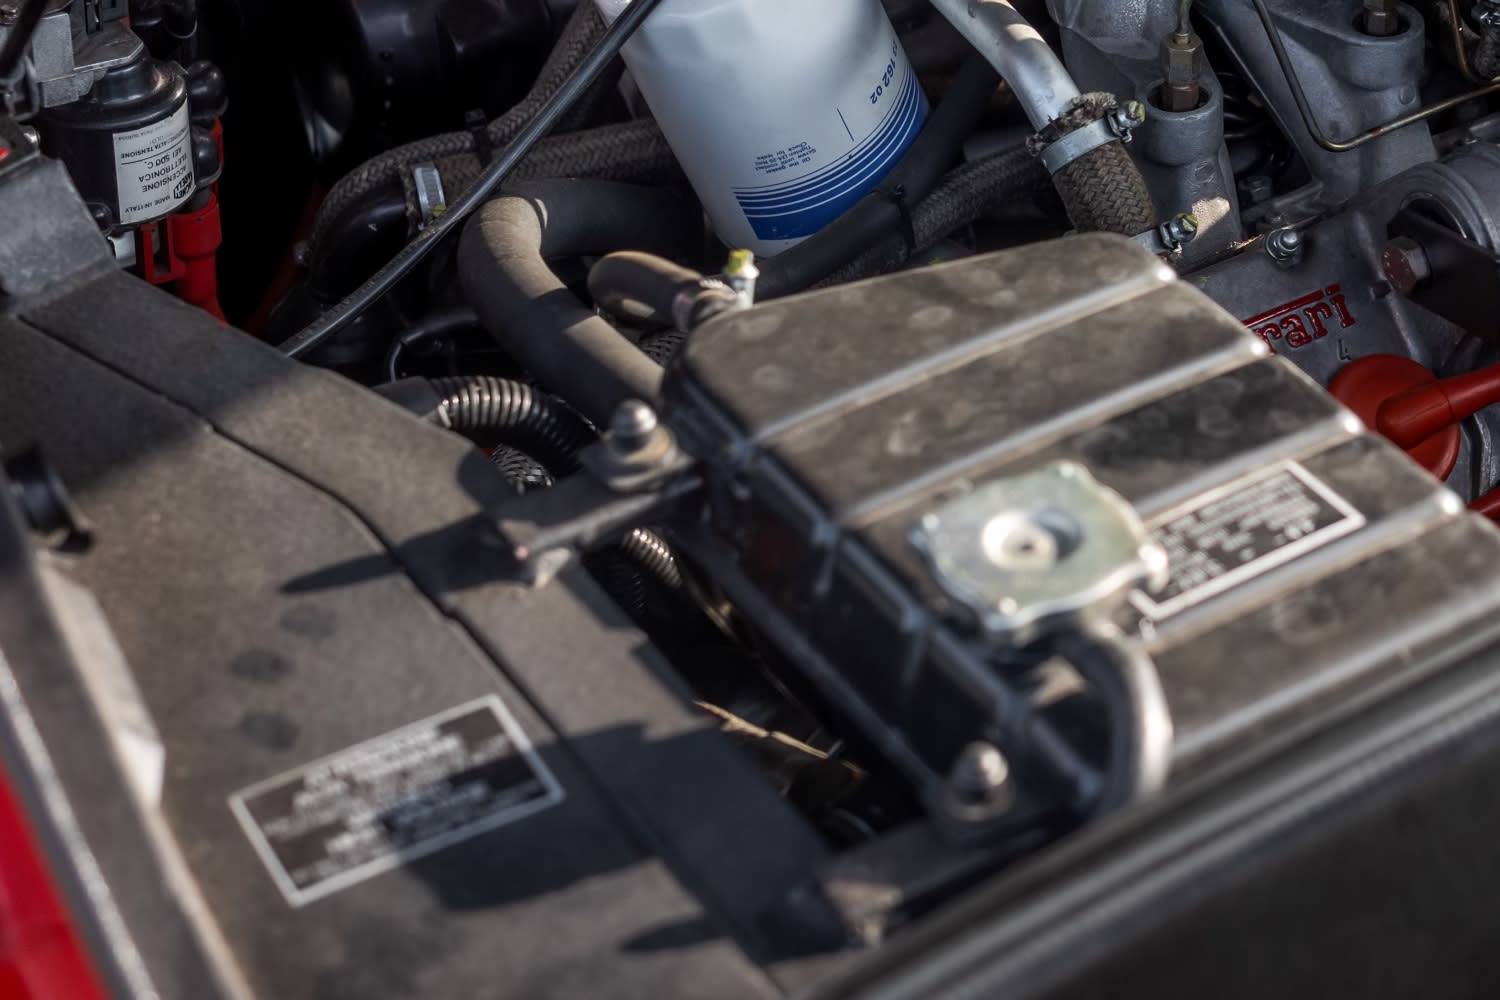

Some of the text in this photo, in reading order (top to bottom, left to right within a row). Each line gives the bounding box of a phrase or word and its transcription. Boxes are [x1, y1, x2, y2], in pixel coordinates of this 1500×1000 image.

[882, 57, 896, 88] 162
[870, 85, 883, 104] 02
[120, 147, 154, 159] TENSIONE
[155, 155, 170, 164] 500
[138, 152, 188, 183] ELETTRONICA
[141, 165, 187, 193] ACCENSIONE
[125, 195, 171, 213] MADE IN ITALY
[1244, 283, 1357, 357] rari
